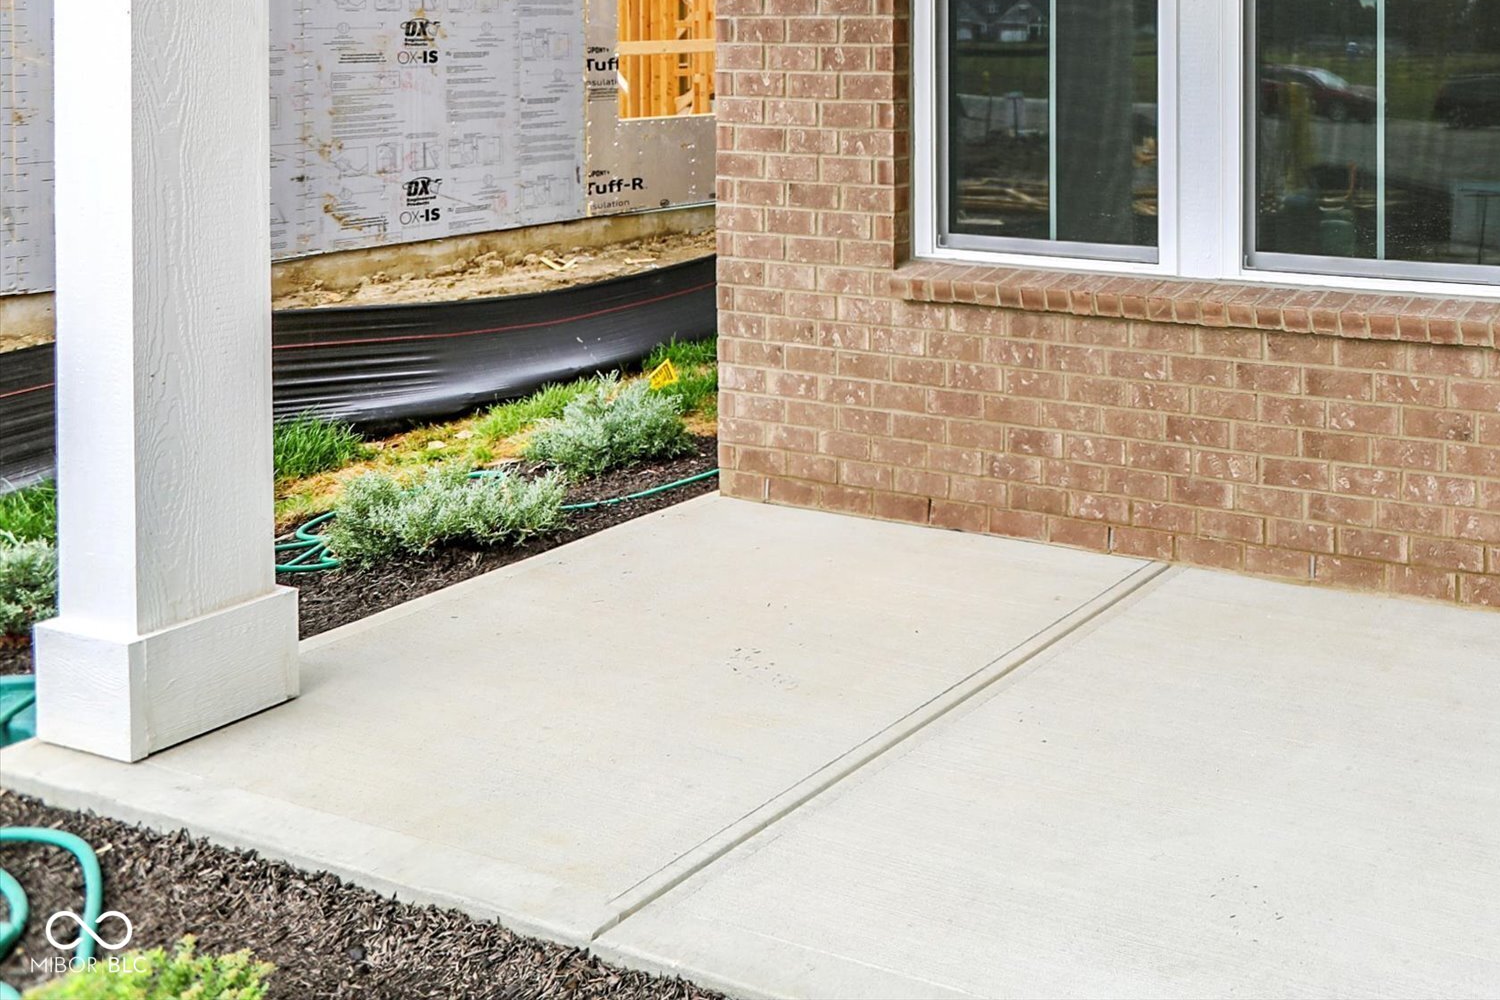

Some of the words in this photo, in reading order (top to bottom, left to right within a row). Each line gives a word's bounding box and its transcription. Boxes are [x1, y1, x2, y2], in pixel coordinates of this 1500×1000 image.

[404, 21, 429, 37] OX
[397, 50, 439, 65] OX-IS
[406, 179, 431, 197] OX
[588, 177, 644, 196] Tuff-R
[399, 207, 441, 226] OX-IS
